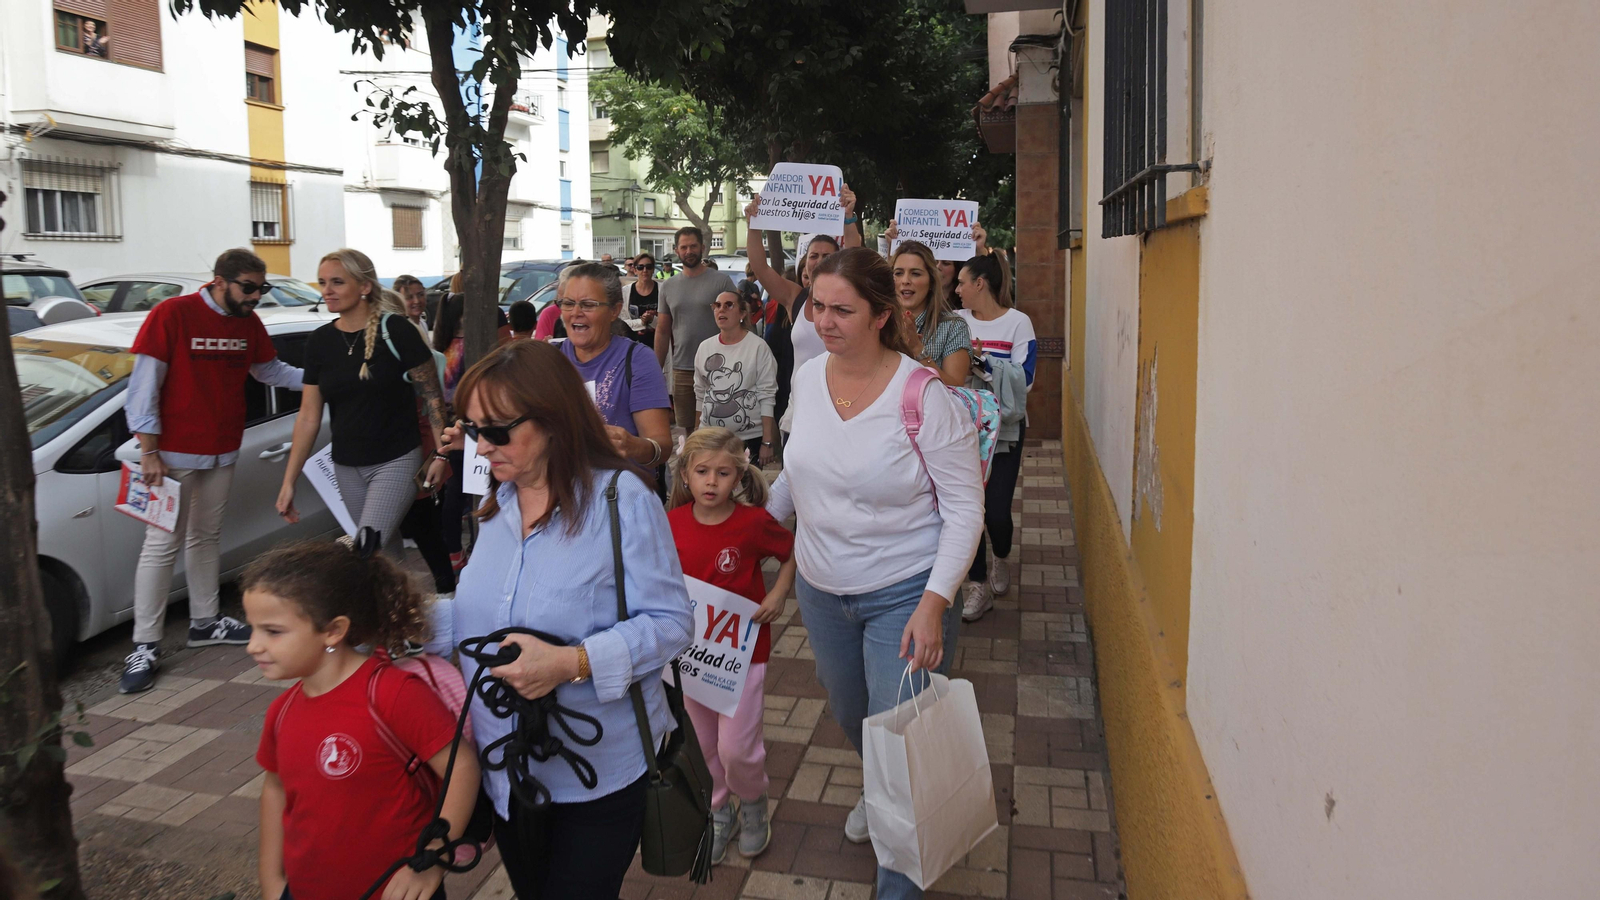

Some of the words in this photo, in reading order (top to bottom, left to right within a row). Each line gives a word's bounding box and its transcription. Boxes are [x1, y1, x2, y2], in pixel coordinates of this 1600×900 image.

[769, 173, 803, 183] OMEDOR
[772, 197, 780, 206] la
[782, 198, 829, 210] Seguridad
[829, 201, 840, 210] de
[792, 209, 816, 220] hij@s
[904, 208, 939, 216] COMEDOR
[903, 217, 941, 226] INFANTIL
[897, 229, 909, 237] Por
[911, 230, 918, 238] la
[919, 230, 962, 242] Seguridad
[929, 240, 951, 249] hij@s
[703, 604, 754, 652] YA!
[683, 645, 726, 668] ridad
[725, 657, 741, 674] de
